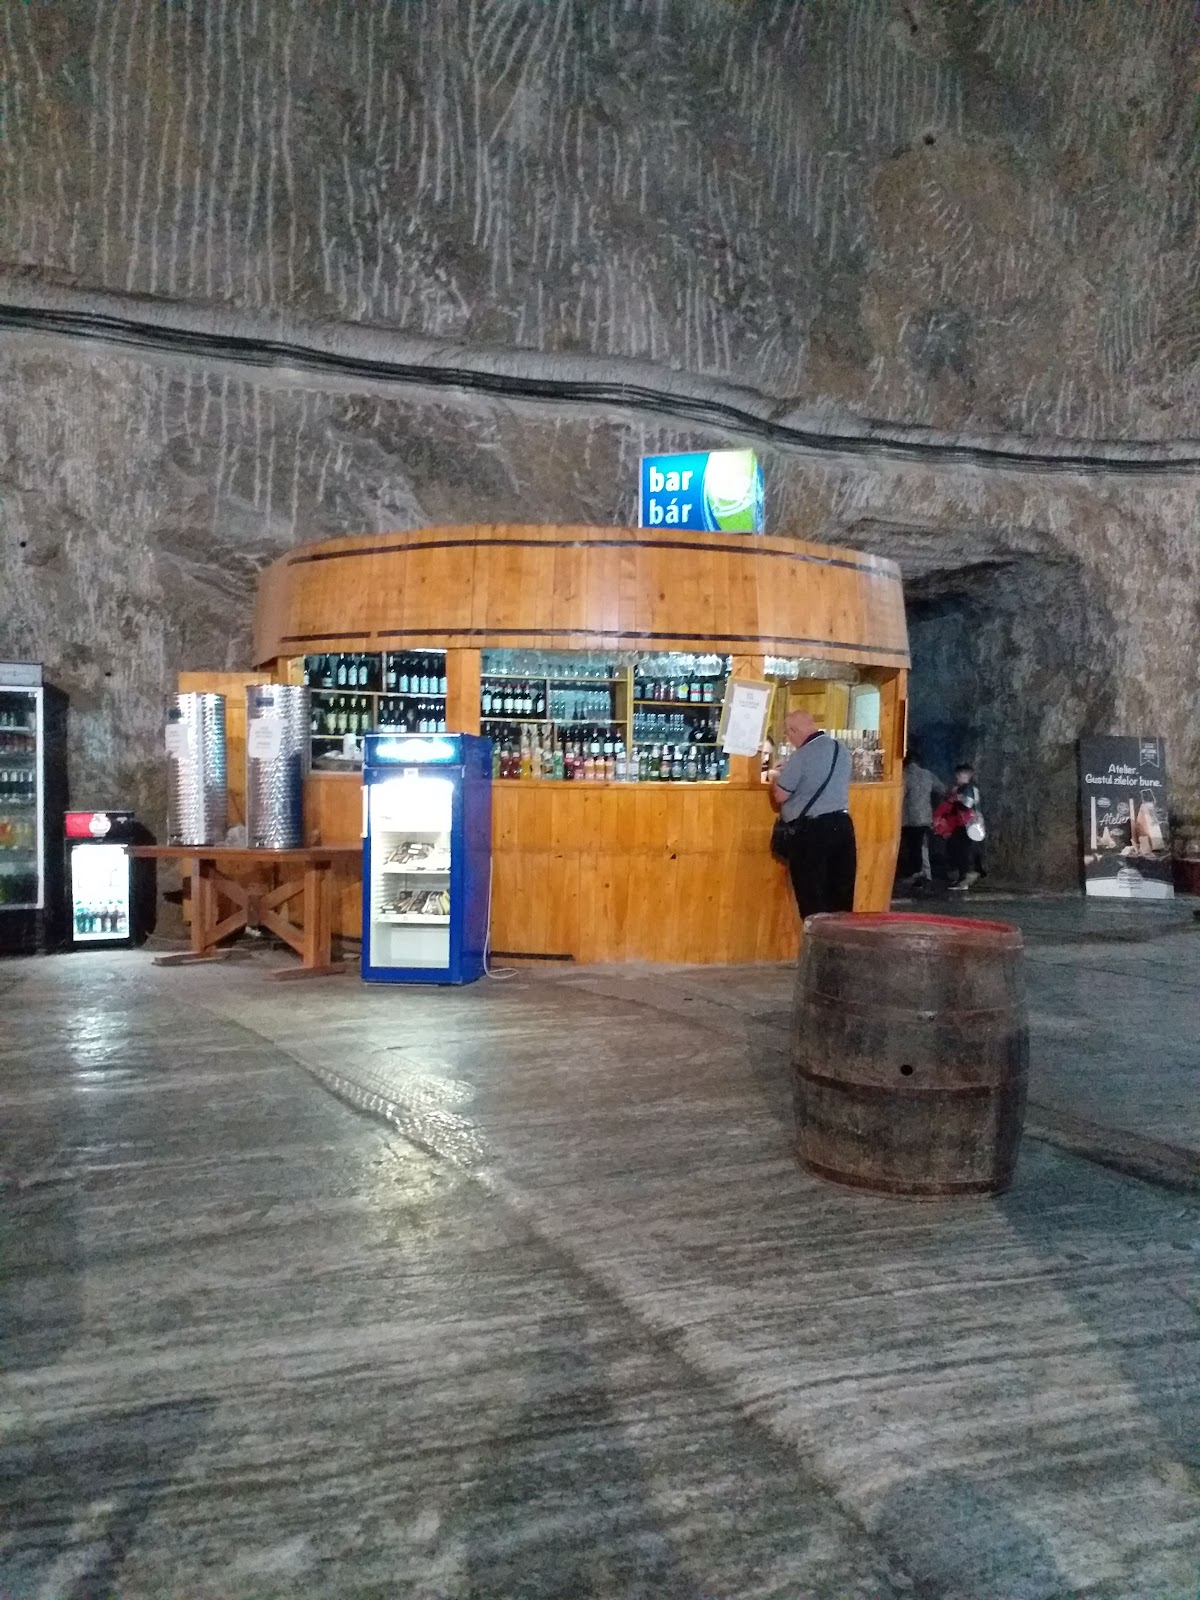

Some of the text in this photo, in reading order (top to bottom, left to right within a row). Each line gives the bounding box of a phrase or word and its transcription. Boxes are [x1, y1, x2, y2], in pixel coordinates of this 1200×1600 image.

[649, 466, 693, 493] bar
[649, 497, 692, 525] bár
[1108, 763, 1139, 775] Atelier.
[1085, 773, 1163, 787] Gustul zilelor bune.
[1099, 812, 1130, 826] Atelier
